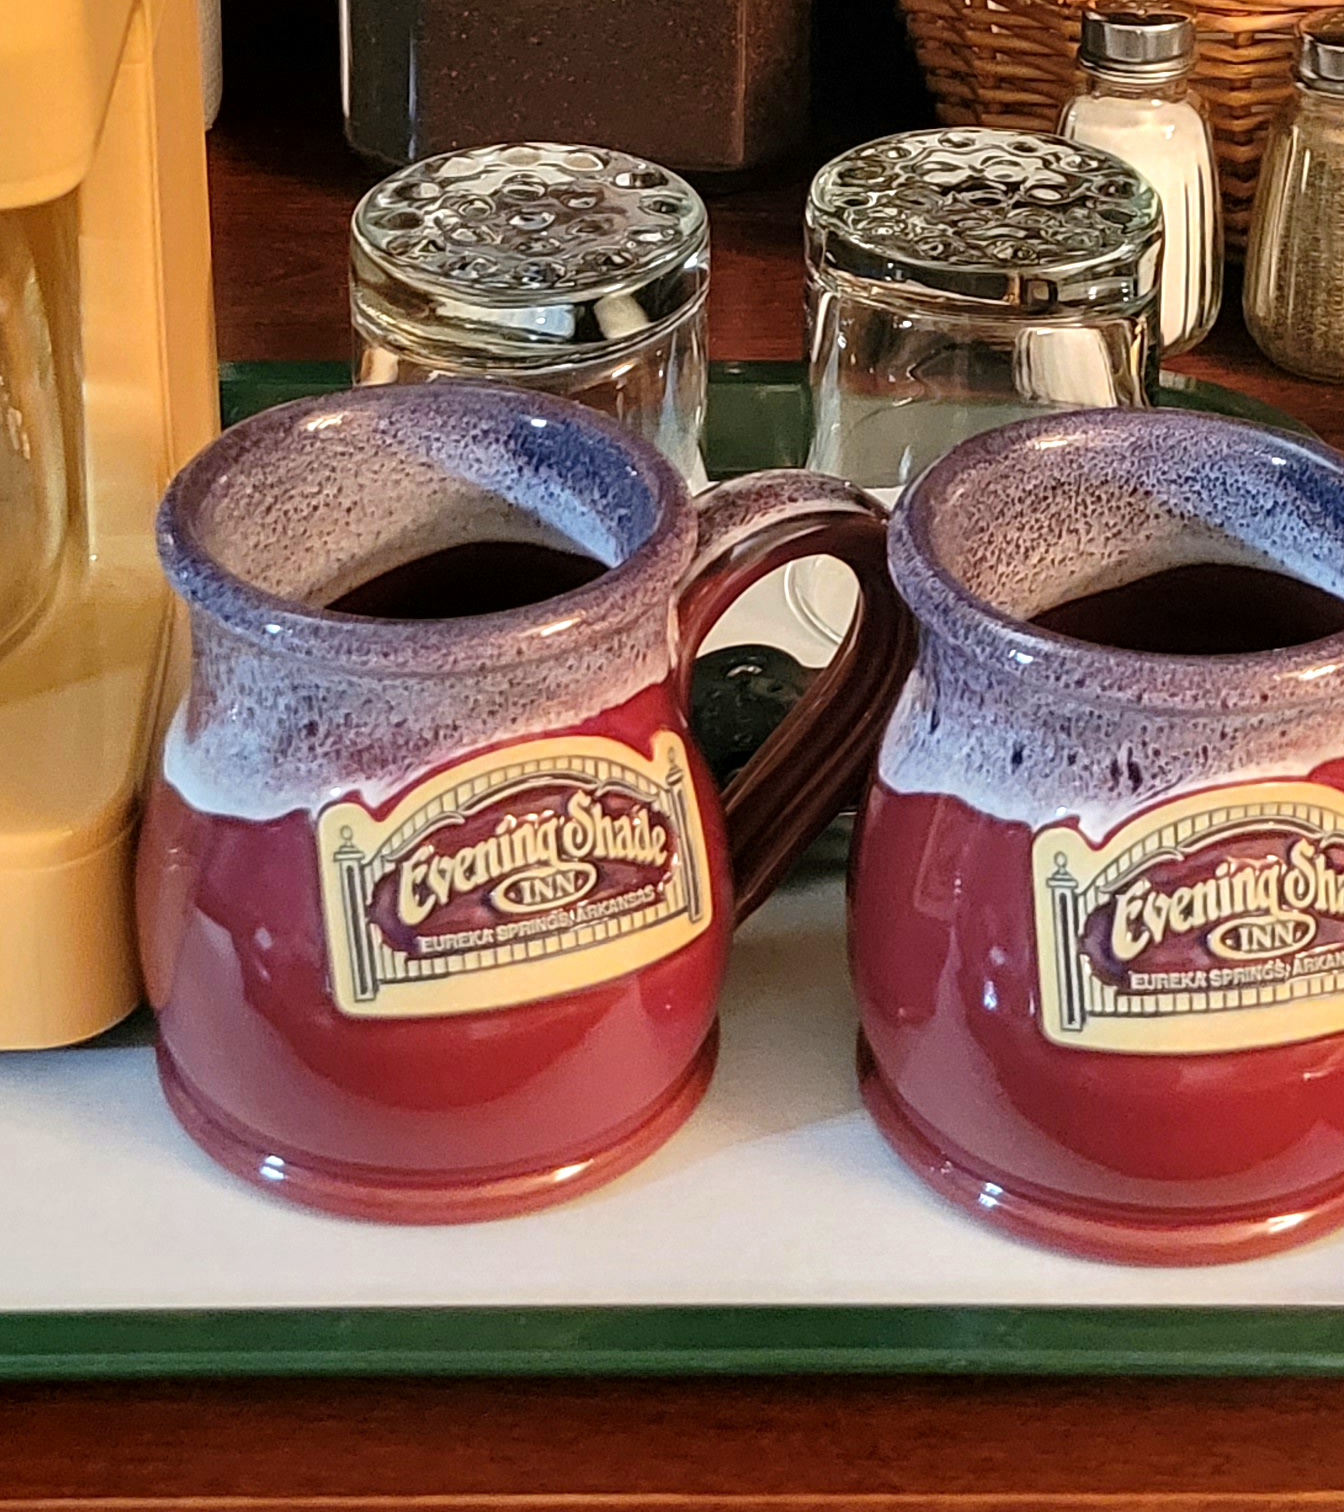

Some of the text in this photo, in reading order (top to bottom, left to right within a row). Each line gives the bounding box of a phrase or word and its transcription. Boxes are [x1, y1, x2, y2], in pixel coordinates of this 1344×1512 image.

[398, 788, 668, 926] Evening Shade
[519, 870, 581, 906] INN
[1112, 862, 1286, 962] Evening
[418, 930, 494, 953] EUREKA
[575, 885, 655, 920] ARKANSAS
[1239, 920, 1297, 952] INN
[1130, 970, 1207, 991] EUREKA
